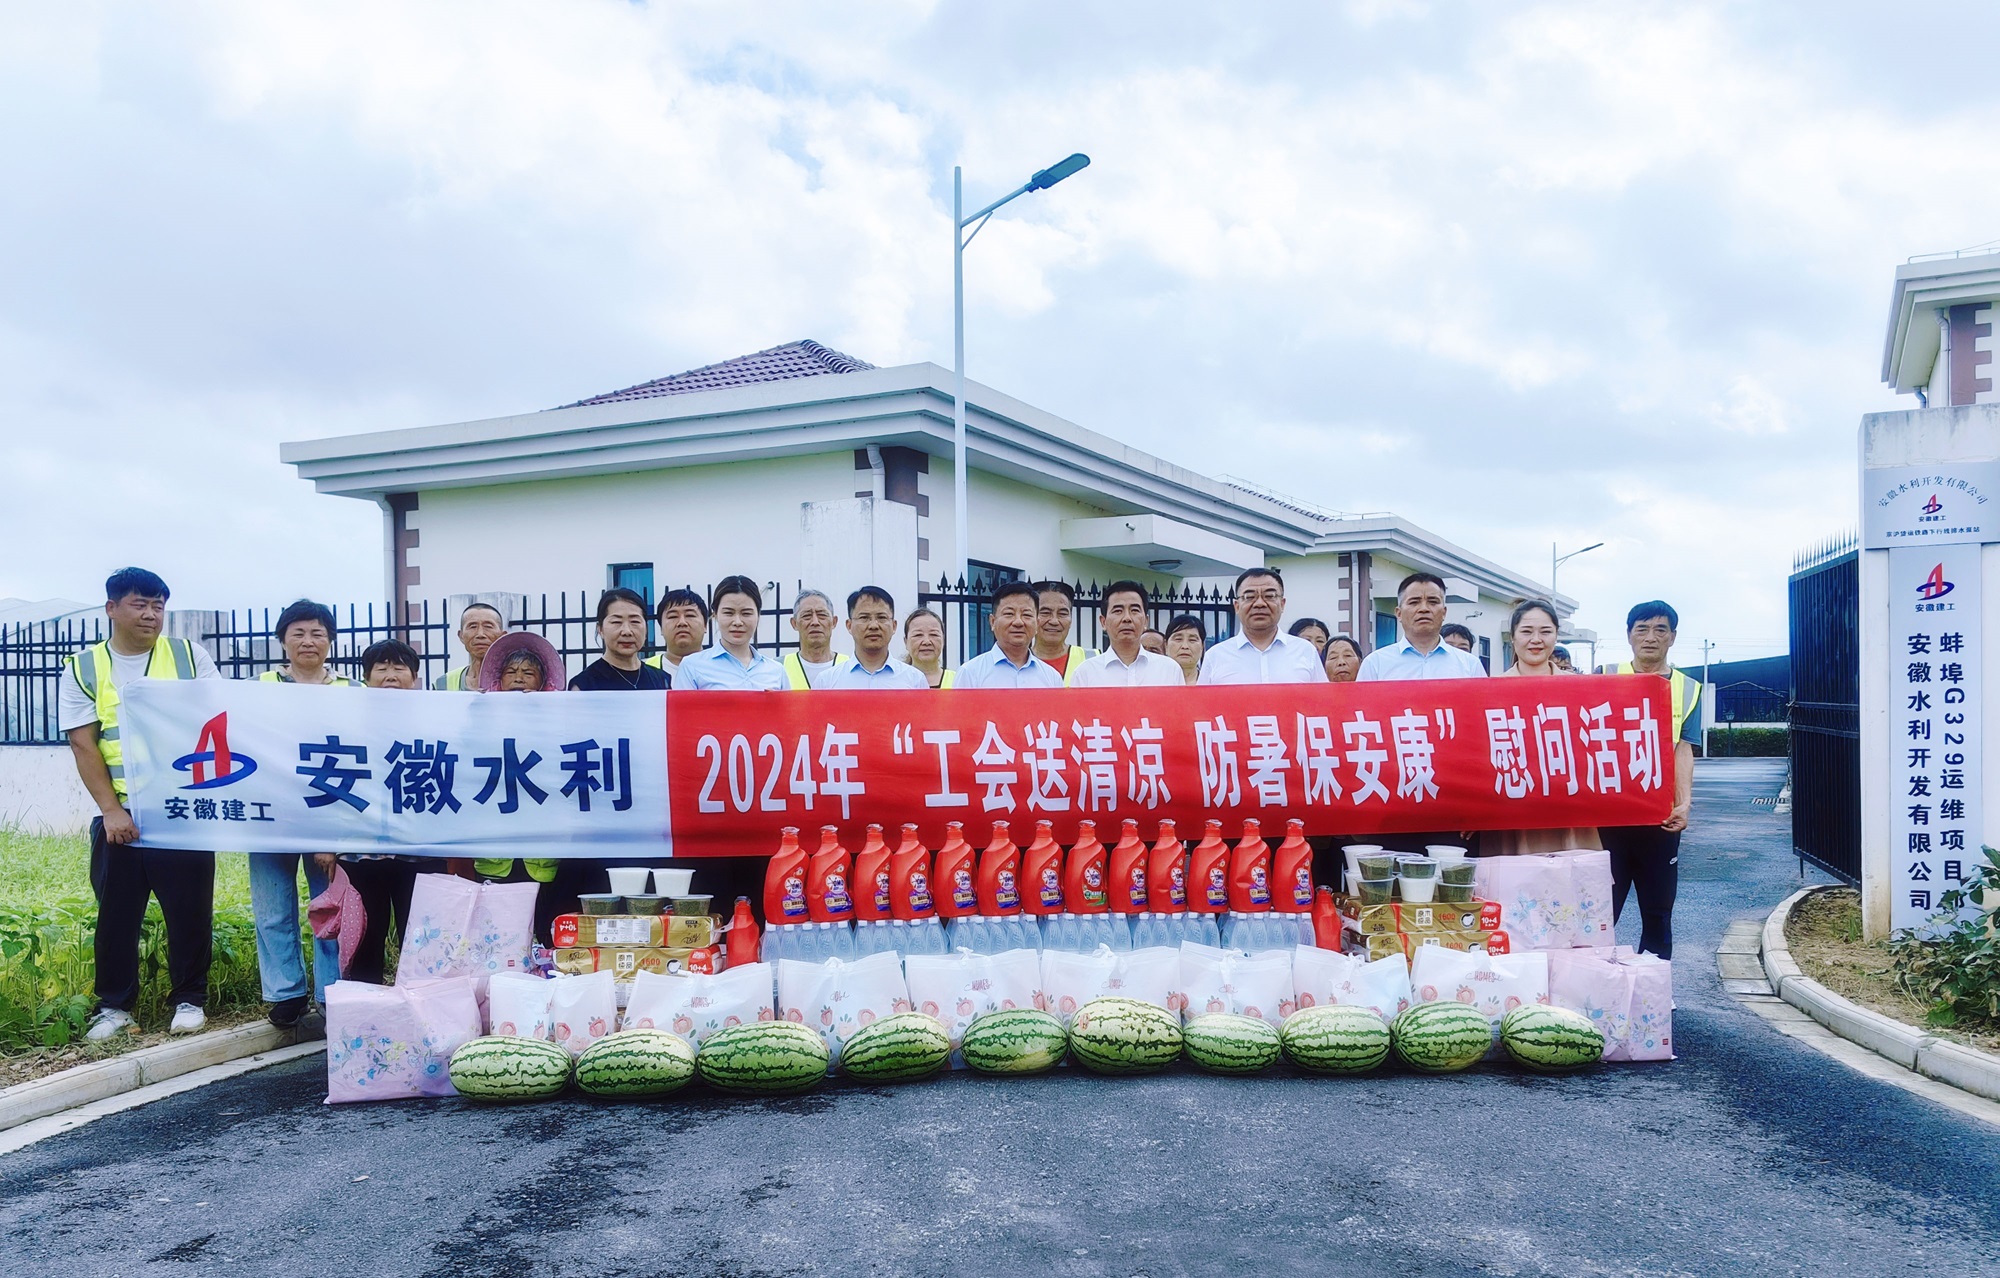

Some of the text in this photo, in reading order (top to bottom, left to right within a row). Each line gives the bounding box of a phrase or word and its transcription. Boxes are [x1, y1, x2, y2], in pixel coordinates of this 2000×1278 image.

[1878, 475, 1988, 508] 安徽水利开发有限公司
[1918, 515, 1947, 523] 安徽建工
[1915, 603, 1956, 612] 安徽建工
[696, 697, 1662, 820] 2024年 “工会送清凉 防暑保安康” 慰问活动
[1907, 632, 1932, 911] 安徽水利开发有限公司
[296, 735, 633, 816] 安徽水利
[164, 796, 275, 823] 安徽建工
[1481, 916, 1498, 924] 10+4
[688, 964, 707, 972] 10+4
